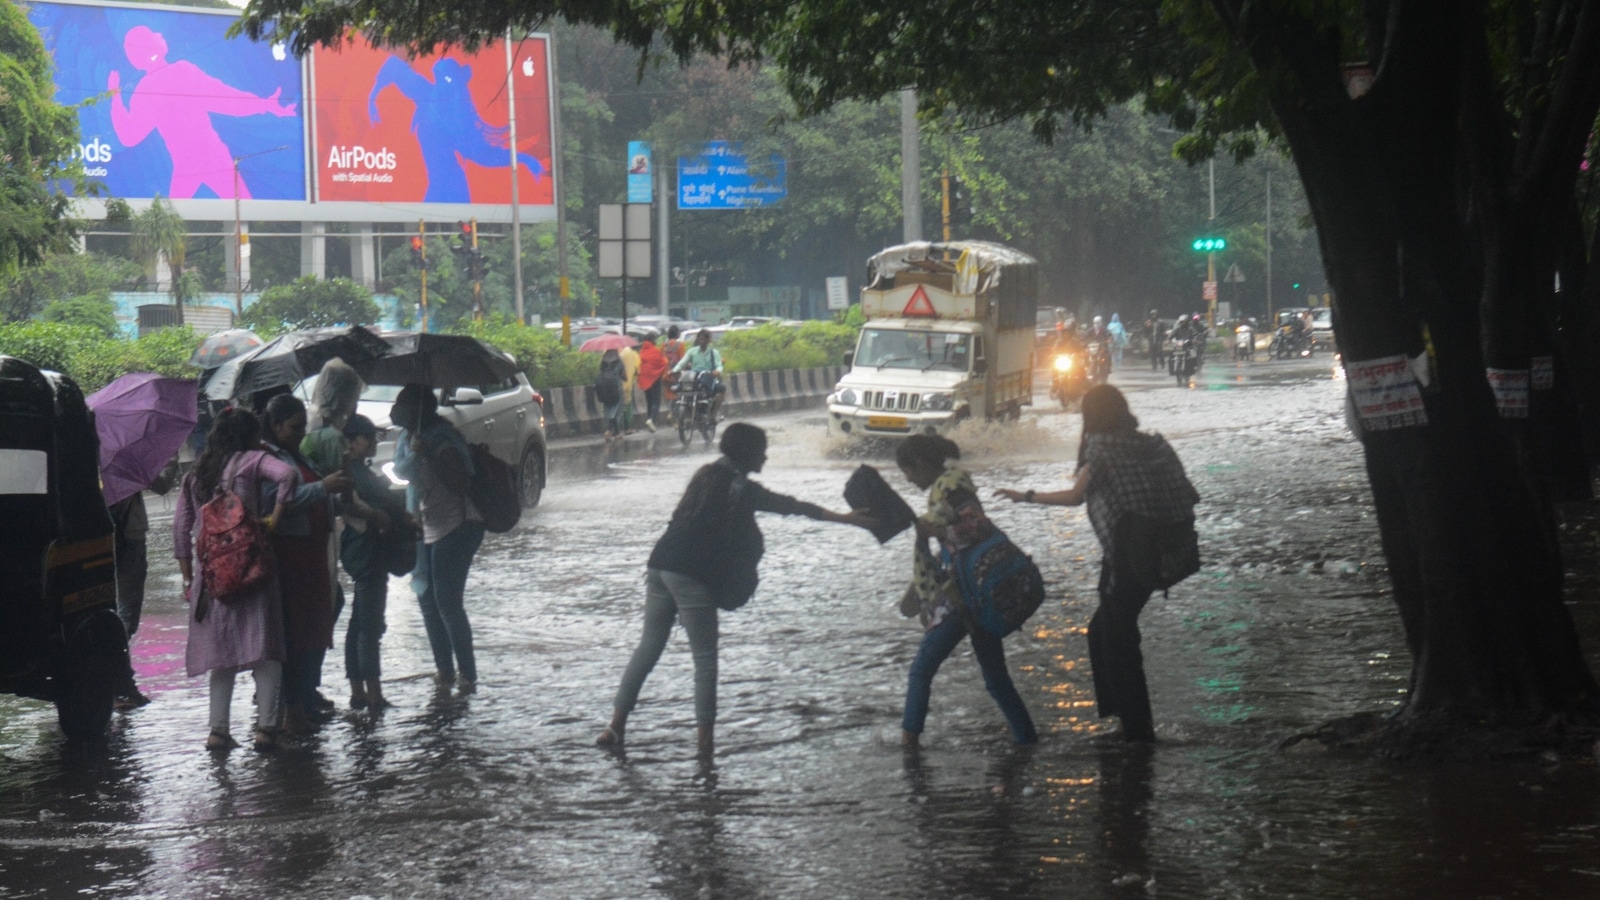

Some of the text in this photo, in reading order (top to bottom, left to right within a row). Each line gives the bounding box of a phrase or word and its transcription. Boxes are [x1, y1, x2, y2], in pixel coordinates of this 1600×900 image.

[328, 145, 397, 170] AirPods
[332, 172, 393, 184] with Spatial Audio
